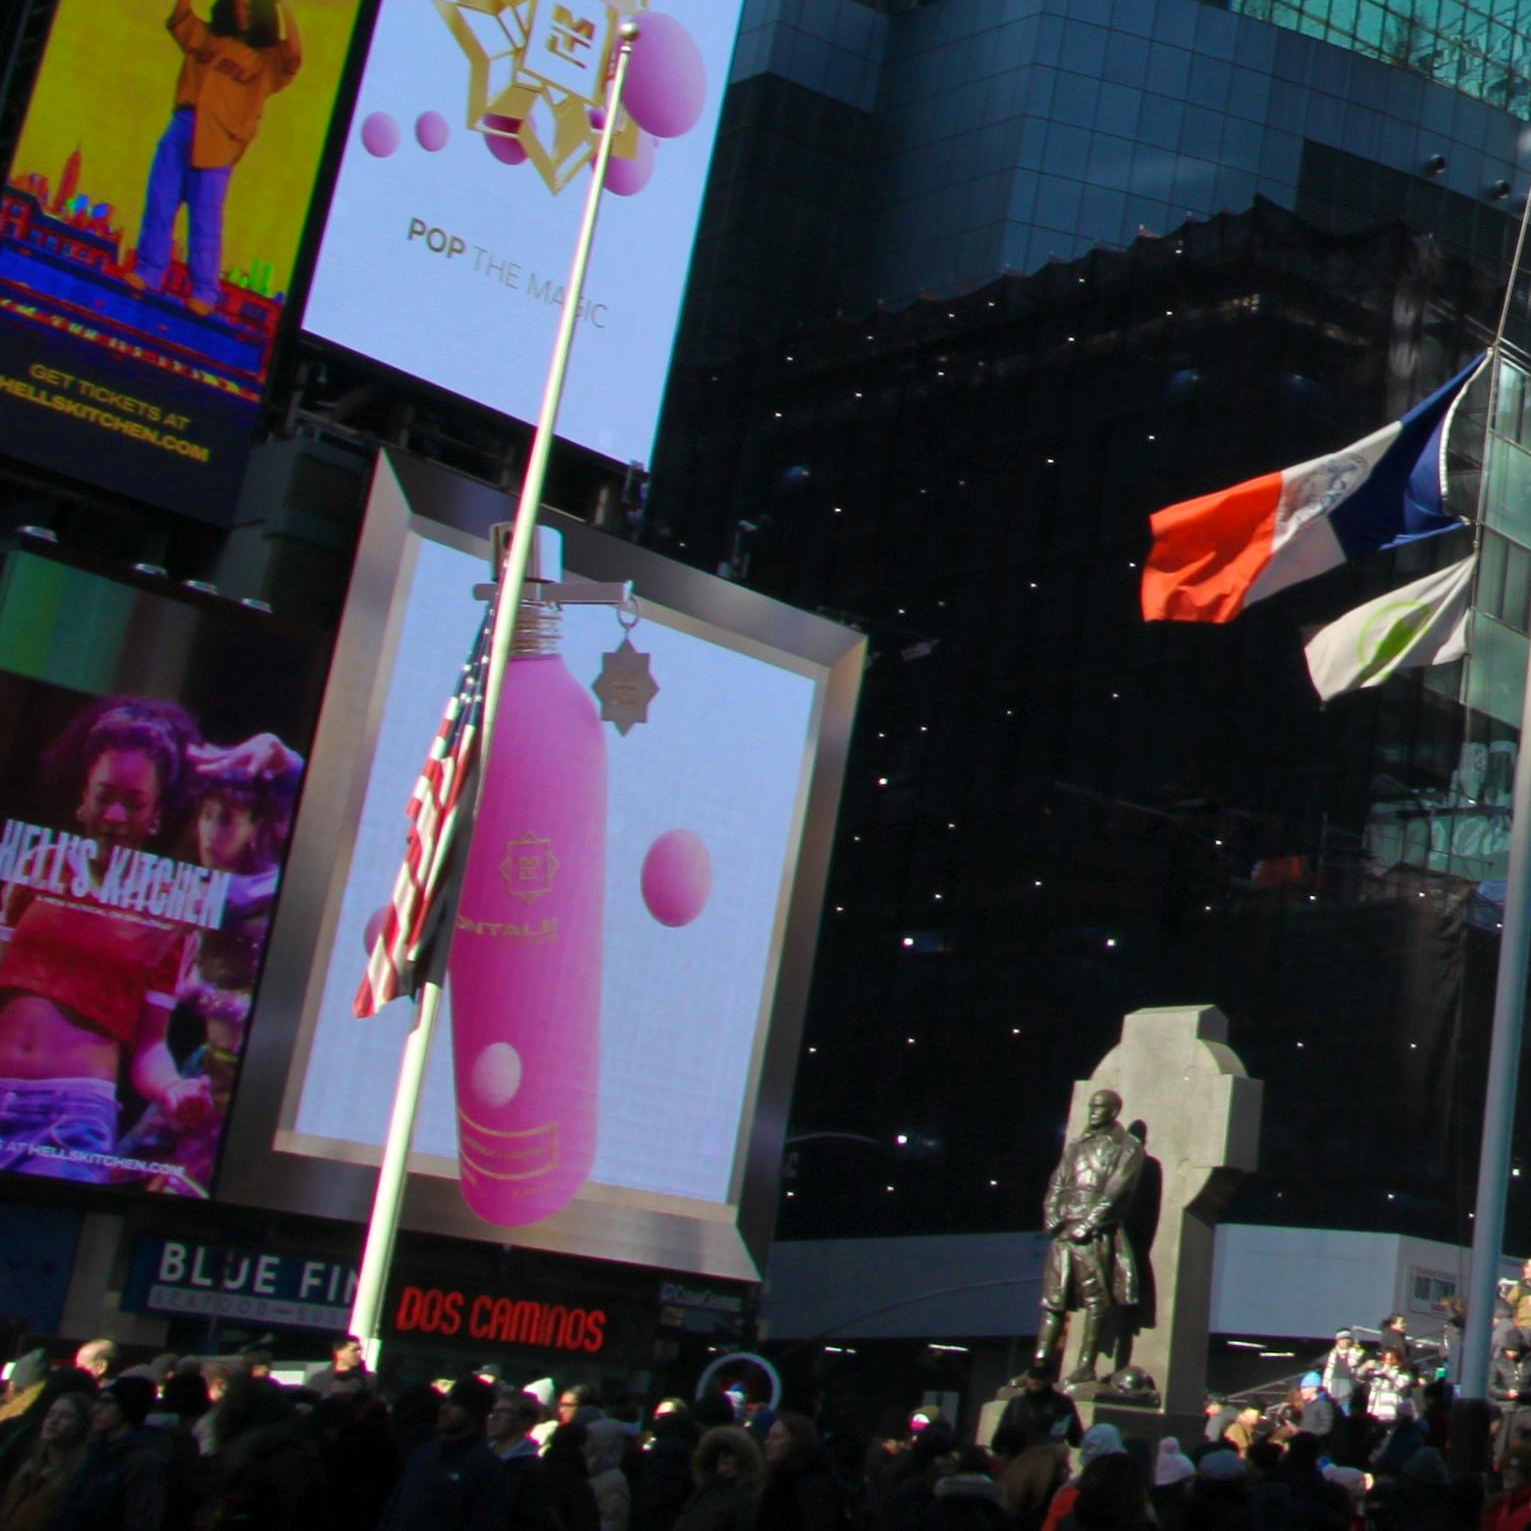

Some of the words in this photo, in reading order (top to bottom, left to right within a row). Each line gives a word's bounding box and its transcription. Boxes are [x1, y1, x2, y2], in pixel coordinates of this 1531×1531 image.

[406, 217, 467, 261] POP
[472, 244, 521, 290] THE
[29, 362, 75, 391] GET
[78, 379, 162, 422] TICKETS
[163, 407, 192, 431] AT
[100, 845, 235, 930] KITCHEN
[158, 1241, 282, 1296] BLUE
[395, 1284, 466, 1337] DOS
[467, 1294, 608, 1354] CAMINOS
